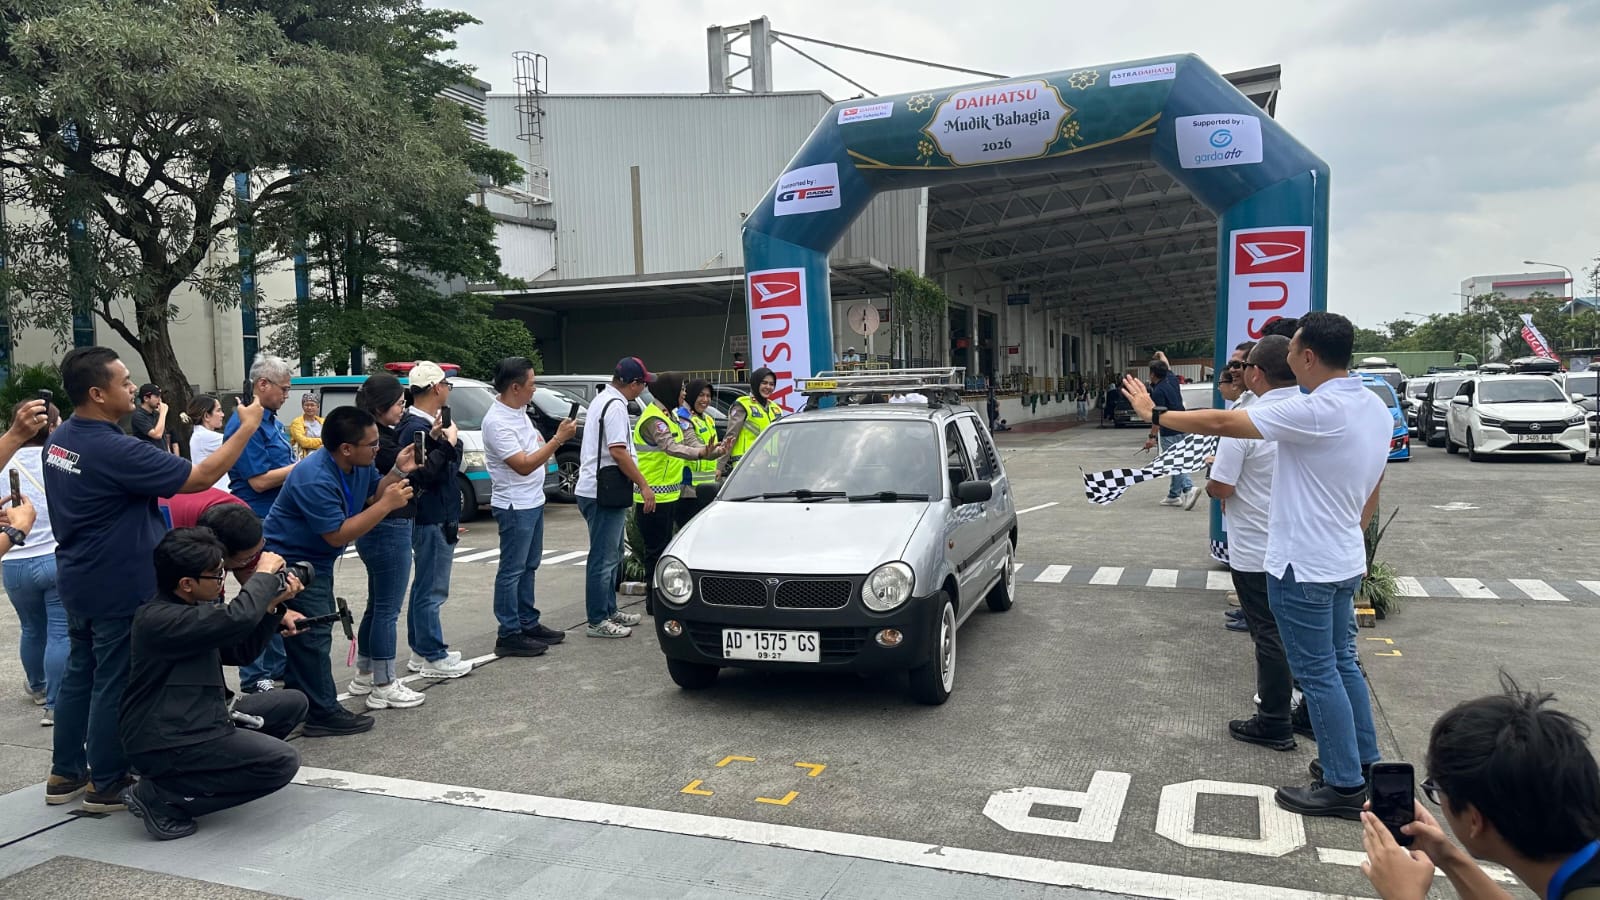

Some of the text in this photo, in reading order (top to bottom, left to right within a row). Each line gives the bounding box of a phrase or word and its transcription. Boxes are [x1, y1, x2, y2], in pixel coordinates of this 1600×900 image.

[955, 88, 1037, 111] DAIHATSU
[943, 108, 1050, 133] Mudik Bahagia
[1192, 119, 1230, 127] Supported
[982, 137, 1012, 152] 2026
[726, 631, 816, 652] AD 1575 GS
